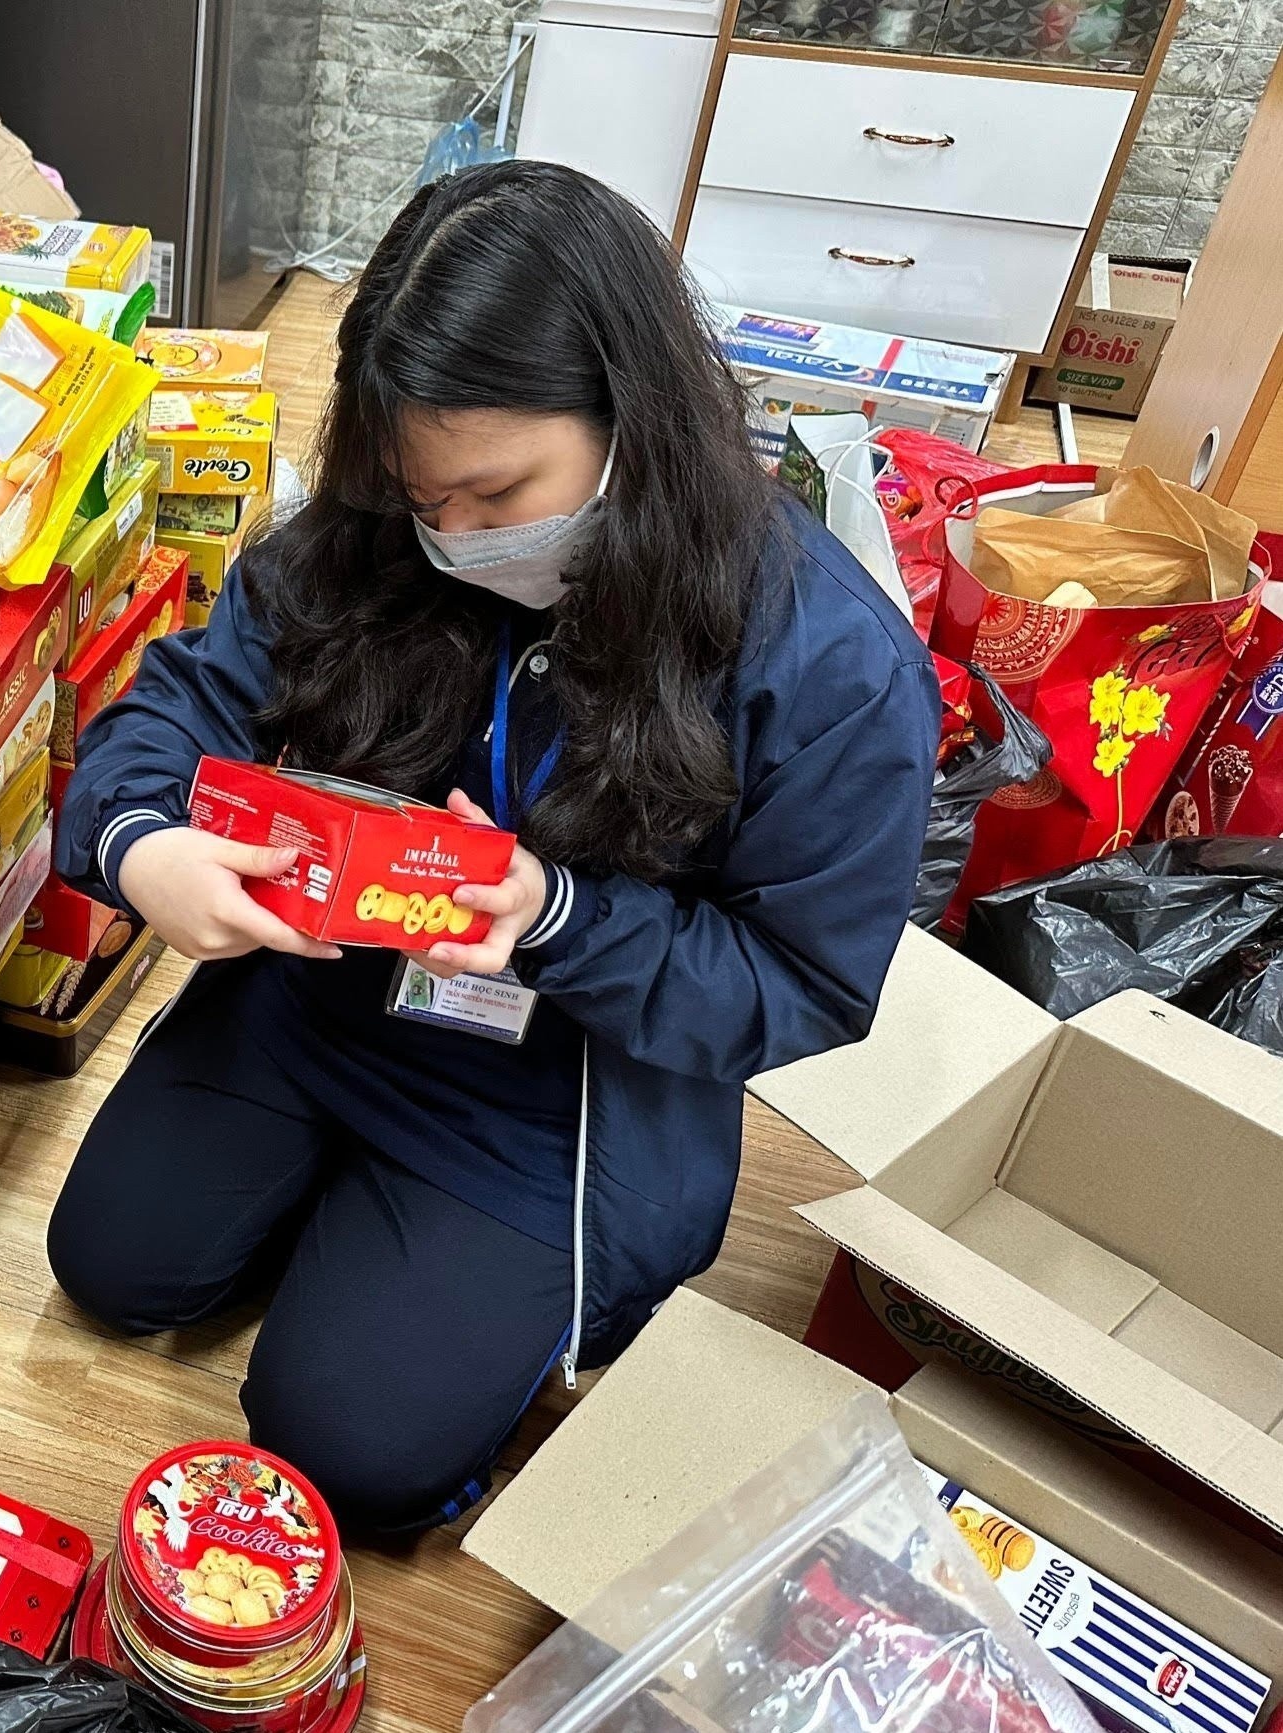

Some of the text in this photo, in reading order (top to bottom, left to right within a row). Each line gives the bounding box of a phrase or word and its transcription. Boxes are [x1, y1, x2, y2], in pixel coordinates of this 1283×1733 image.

[1061, 324, 1143, 366] Oishi
[1065, 372, 1085, 383] SIZE
[78, 587, 92, 624] LU
[403, 849, 459, 867] IMPERIAL
[495, 989, 519, 1000] SINH
[189, 1516, 301, 1560] Cookies
[1053, 1592, 1080, 1630] BISCUITS
